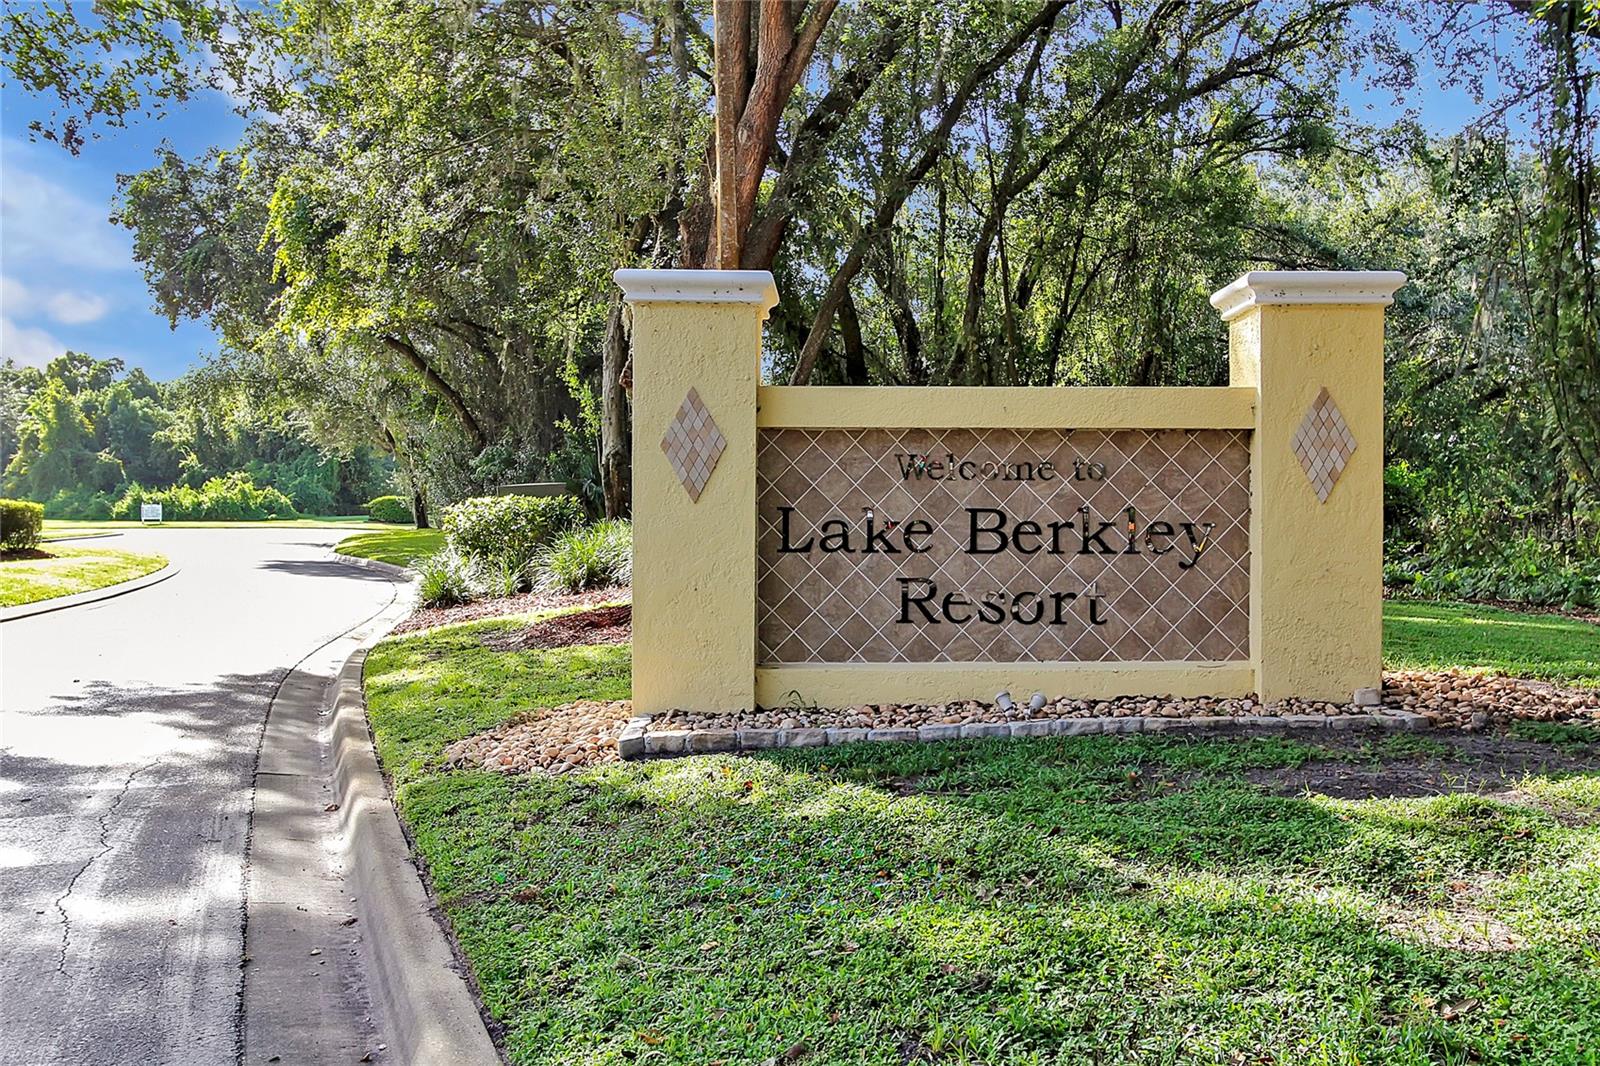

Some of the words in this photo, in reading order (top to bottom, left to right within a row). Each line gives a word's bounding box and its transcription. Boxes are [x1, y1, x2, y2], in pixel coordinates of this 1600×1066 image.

[895, 453, 1055, 482] Welcome
[1073, 456, 1107, 482] to
[776, 506, 934, 556] Lake
[965, 506, 1216, 570] Berkley
[895, 577, 1108, 626] Resort
